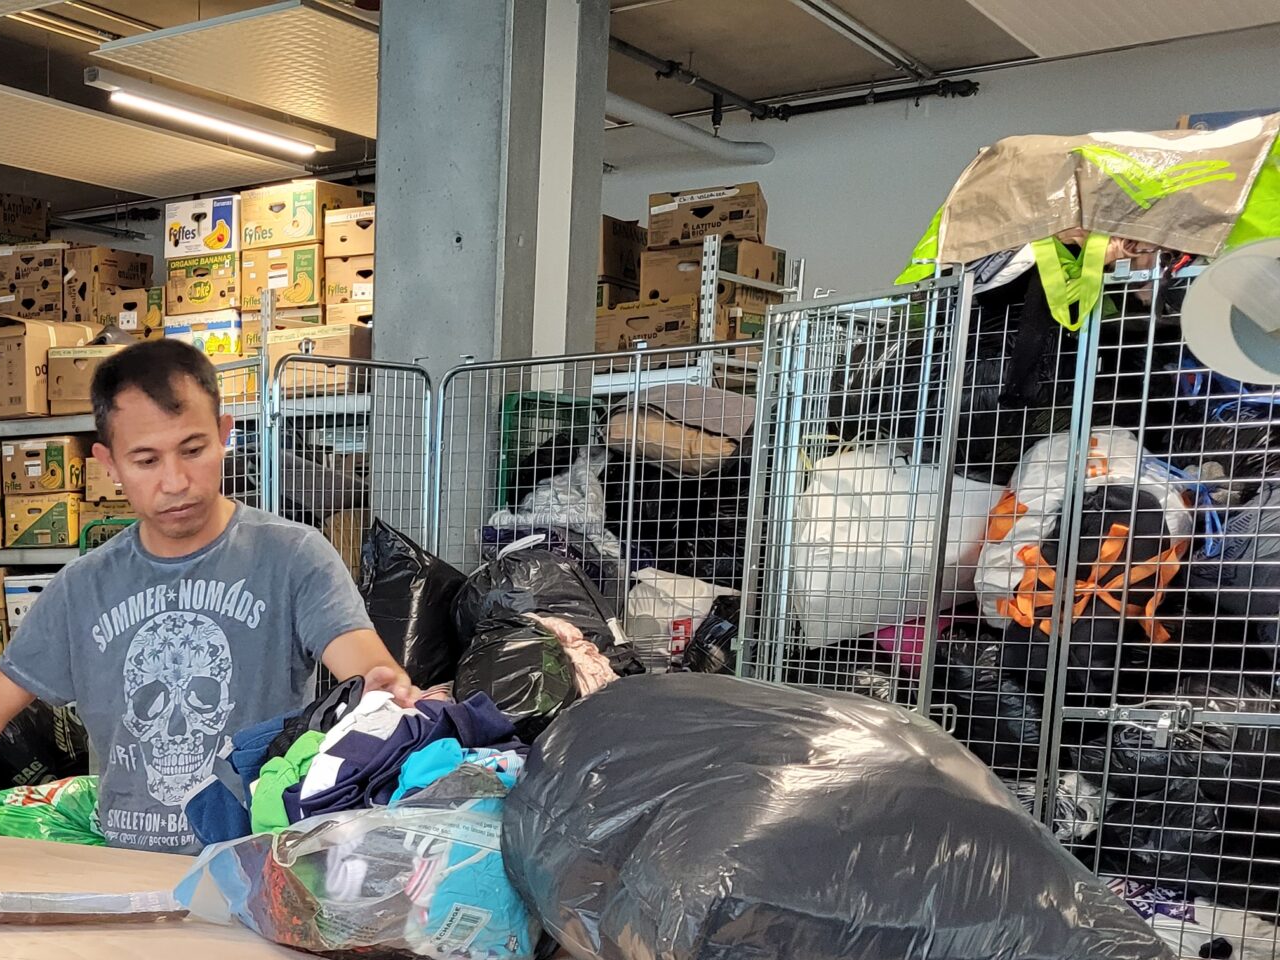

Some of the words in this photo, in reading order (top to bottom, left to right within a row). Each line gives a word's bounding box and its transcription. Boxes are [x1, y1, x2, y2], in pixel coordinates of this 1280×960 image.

[691, 221, 722, 231] LATITUD
[170, 258, 199, 269] ORGANIC
[200, 254, 232, 265] BANANAS
[92, 584, 167, 653] SUMMER
[179, 579, 266, 630] NOMADS
[12, 760, 44, 785] BAG
[107, 808, 161, 833] SKELETON
[167, 813, 189, 834] BA
